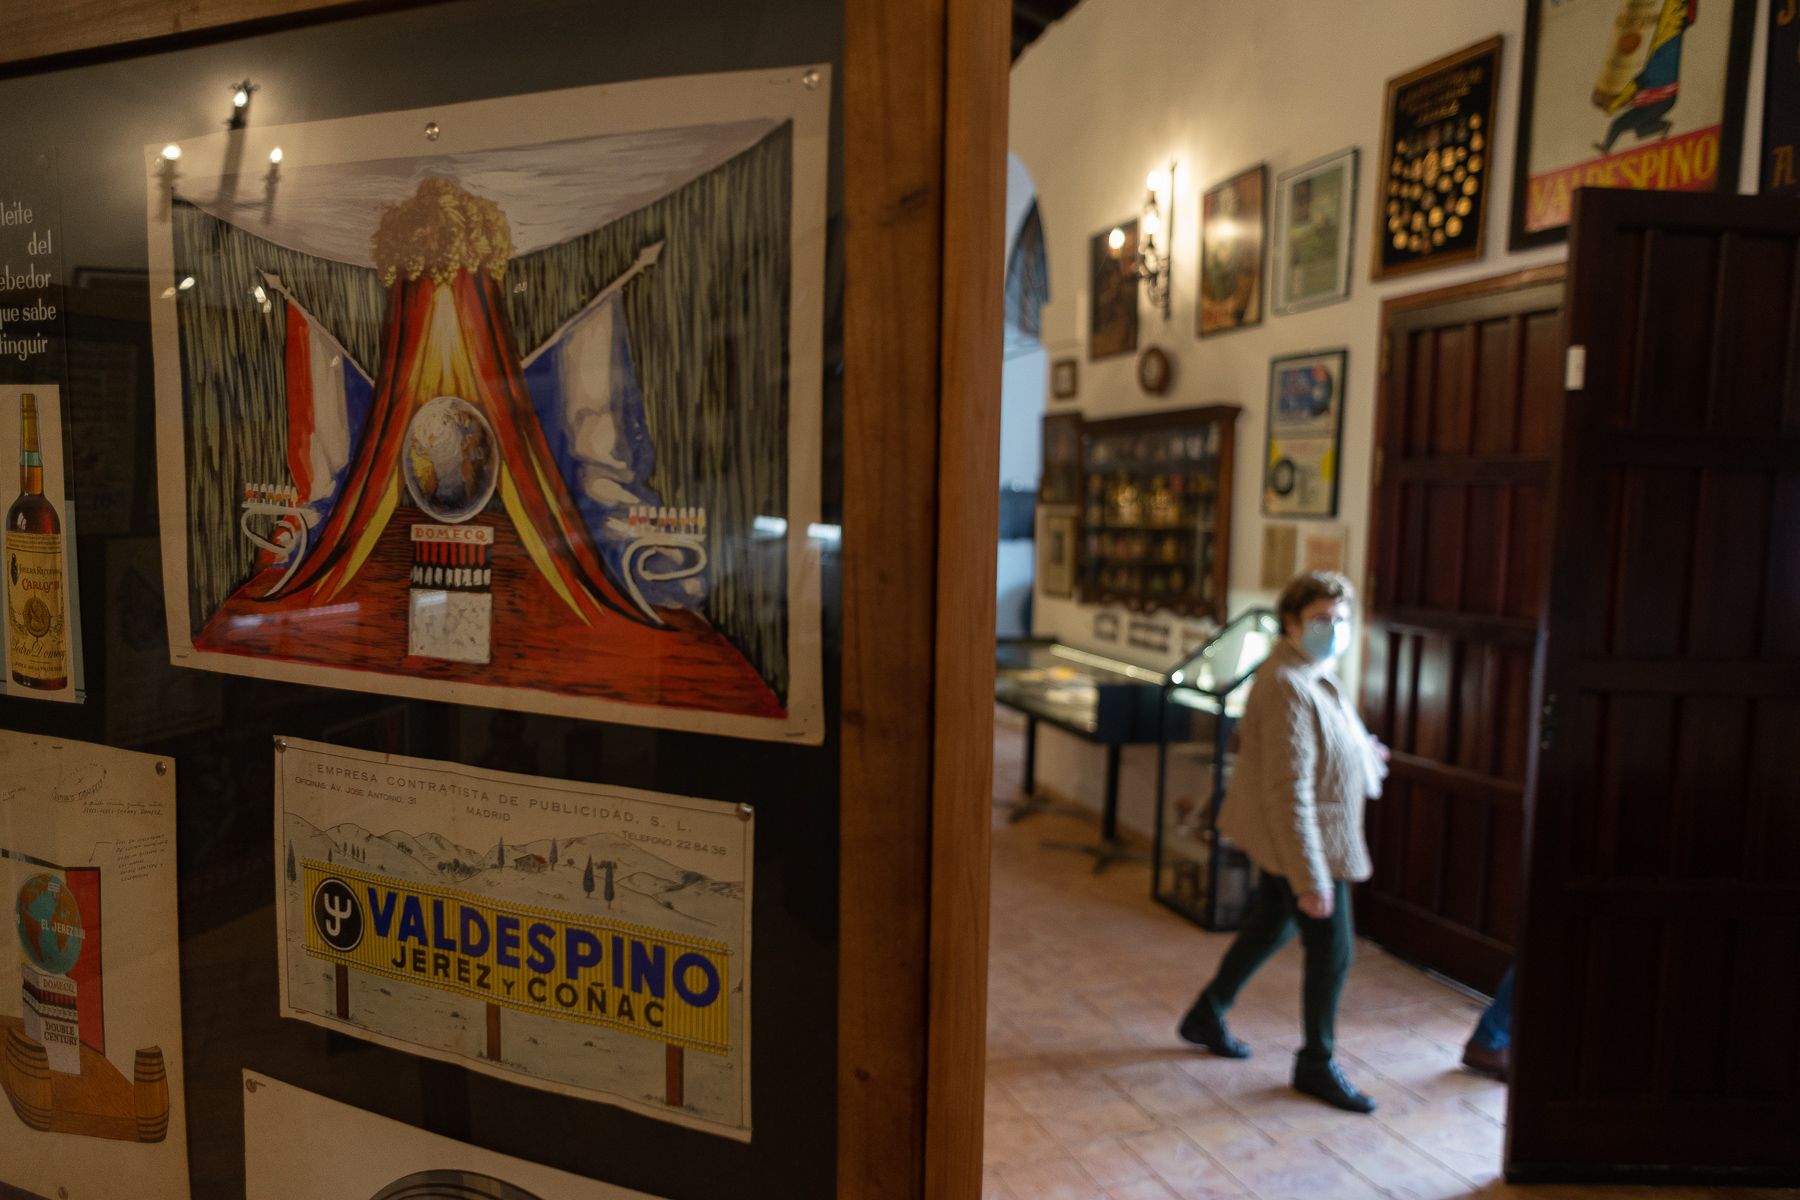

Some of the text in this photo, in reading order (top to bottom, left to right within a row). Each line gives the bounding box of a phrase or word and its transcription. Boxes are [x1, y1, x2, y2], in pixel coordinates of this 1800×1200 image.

[28, 230, 52, 255] del
[0, 298, 57, 330] ue sabe
[415, 527, 487, 542] DOMECQ
[317, 764, 378, 782] EMPRESA
[387, 776, 489, 801] CONTRATISTA
[499, 794, 518, 806] DE
[651, 816, 665, 828] S.
[677, 820, 692, 832] L.
[466, 806, 511, 821] MADRID
[41, 918, 49, 930] EL
[367, 888, 720, 1007] VALDESPINO
[43, 978, 76, 993] DOMECQ
[391, 944, 493, 990] JEREZ
[527, 978, 666, 1028] COÑAC
[45, 1021, 75, 1036] DOUBLE
[44, 1031, 78, 1046] CENTURY
